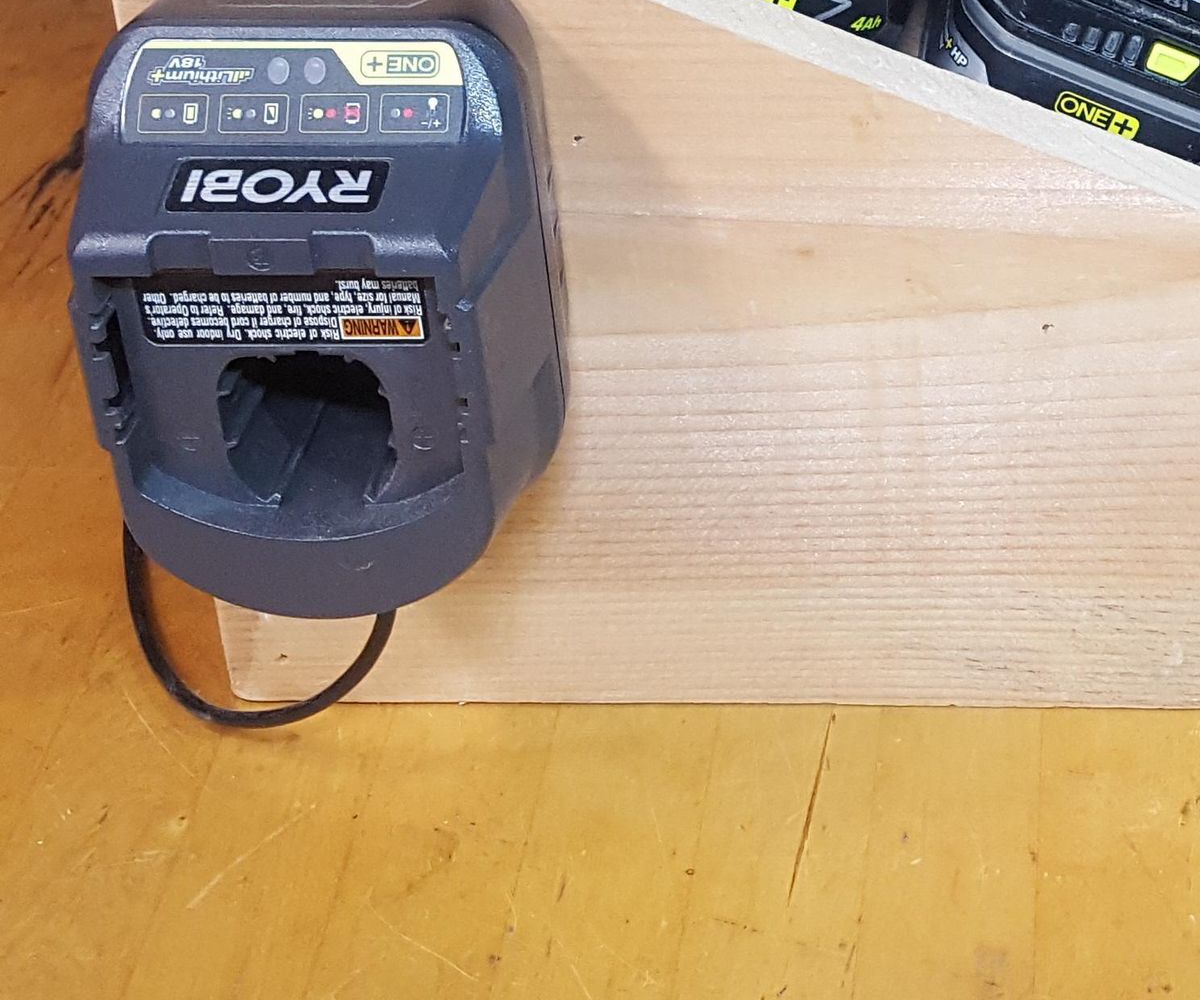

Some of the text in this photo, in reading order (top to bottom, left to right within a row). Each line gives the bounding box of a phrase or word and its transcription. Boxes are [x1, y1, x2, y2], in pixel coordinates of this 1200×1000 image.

[850, 15, 881, 31] 4Ah
[169, 56, 204, 68] 18V
[180, 169, 373, 203] RYOBI
[335, 278, 418, 291] batteries may burst.
[144, 290, 421, 304] Manual for size, type, and number of batteries to be charged. Other
[145, 302, 422, 316] Risk of injury, electric shock, fire, and damage. Refer to Operator's
[147, 315, 337, 328] Dispose of charger if cord becomes defective.
[344, 319, 399, 336] WARNING
[154, 327, 340, 340] Risk of electric shock. Dry indoor use only.
